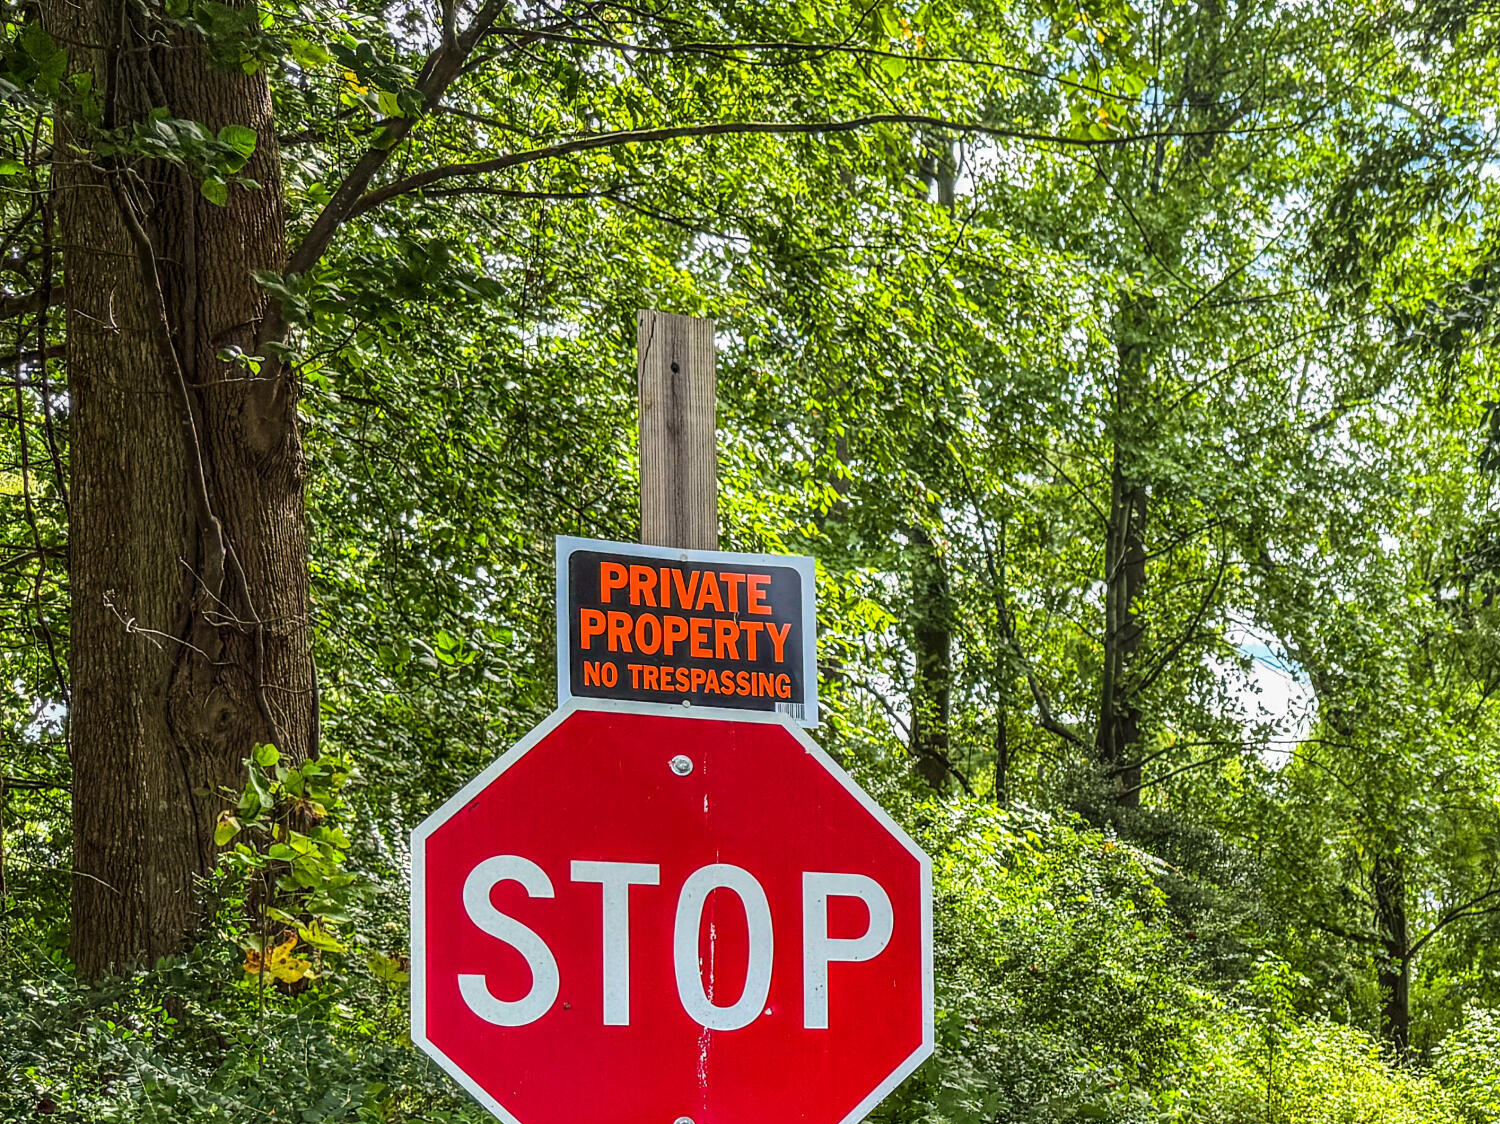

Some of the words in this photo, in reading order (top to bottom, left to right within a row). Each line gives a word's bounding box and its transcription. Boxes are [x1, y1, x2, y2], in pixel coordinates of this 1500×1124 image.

[600, 561, 772, 615] PRIVATE
[580, 608, 792, 663] PROPERTY
[583, 660, 618, 688] NO
[627, 664, 791, 698] TRESPASSING
[457, 854, 894, 1031] STOP
